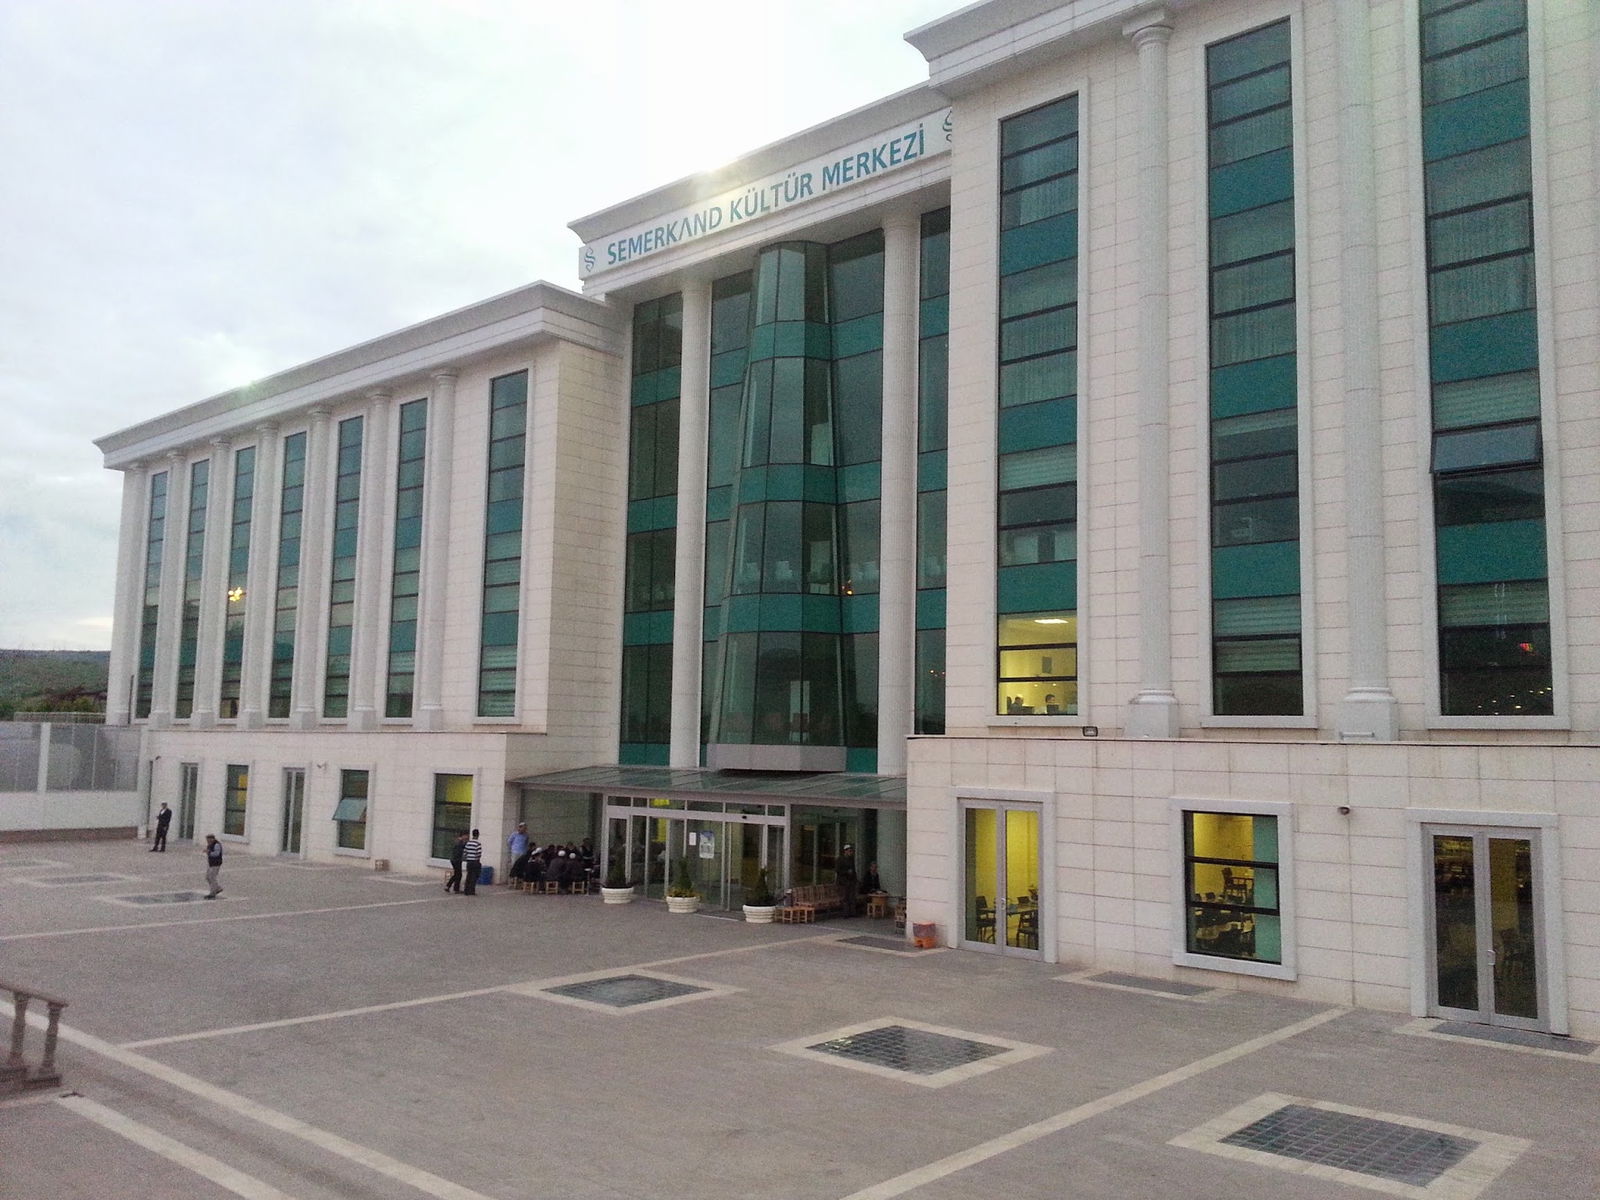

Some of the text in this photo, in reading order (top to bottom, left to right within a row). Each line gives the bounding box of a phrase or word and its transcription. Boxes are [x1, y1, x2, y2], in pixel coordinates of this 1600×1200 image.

[607, 123, 925, 265] SEMERKAND KÜLTÜR MERKEZİ
